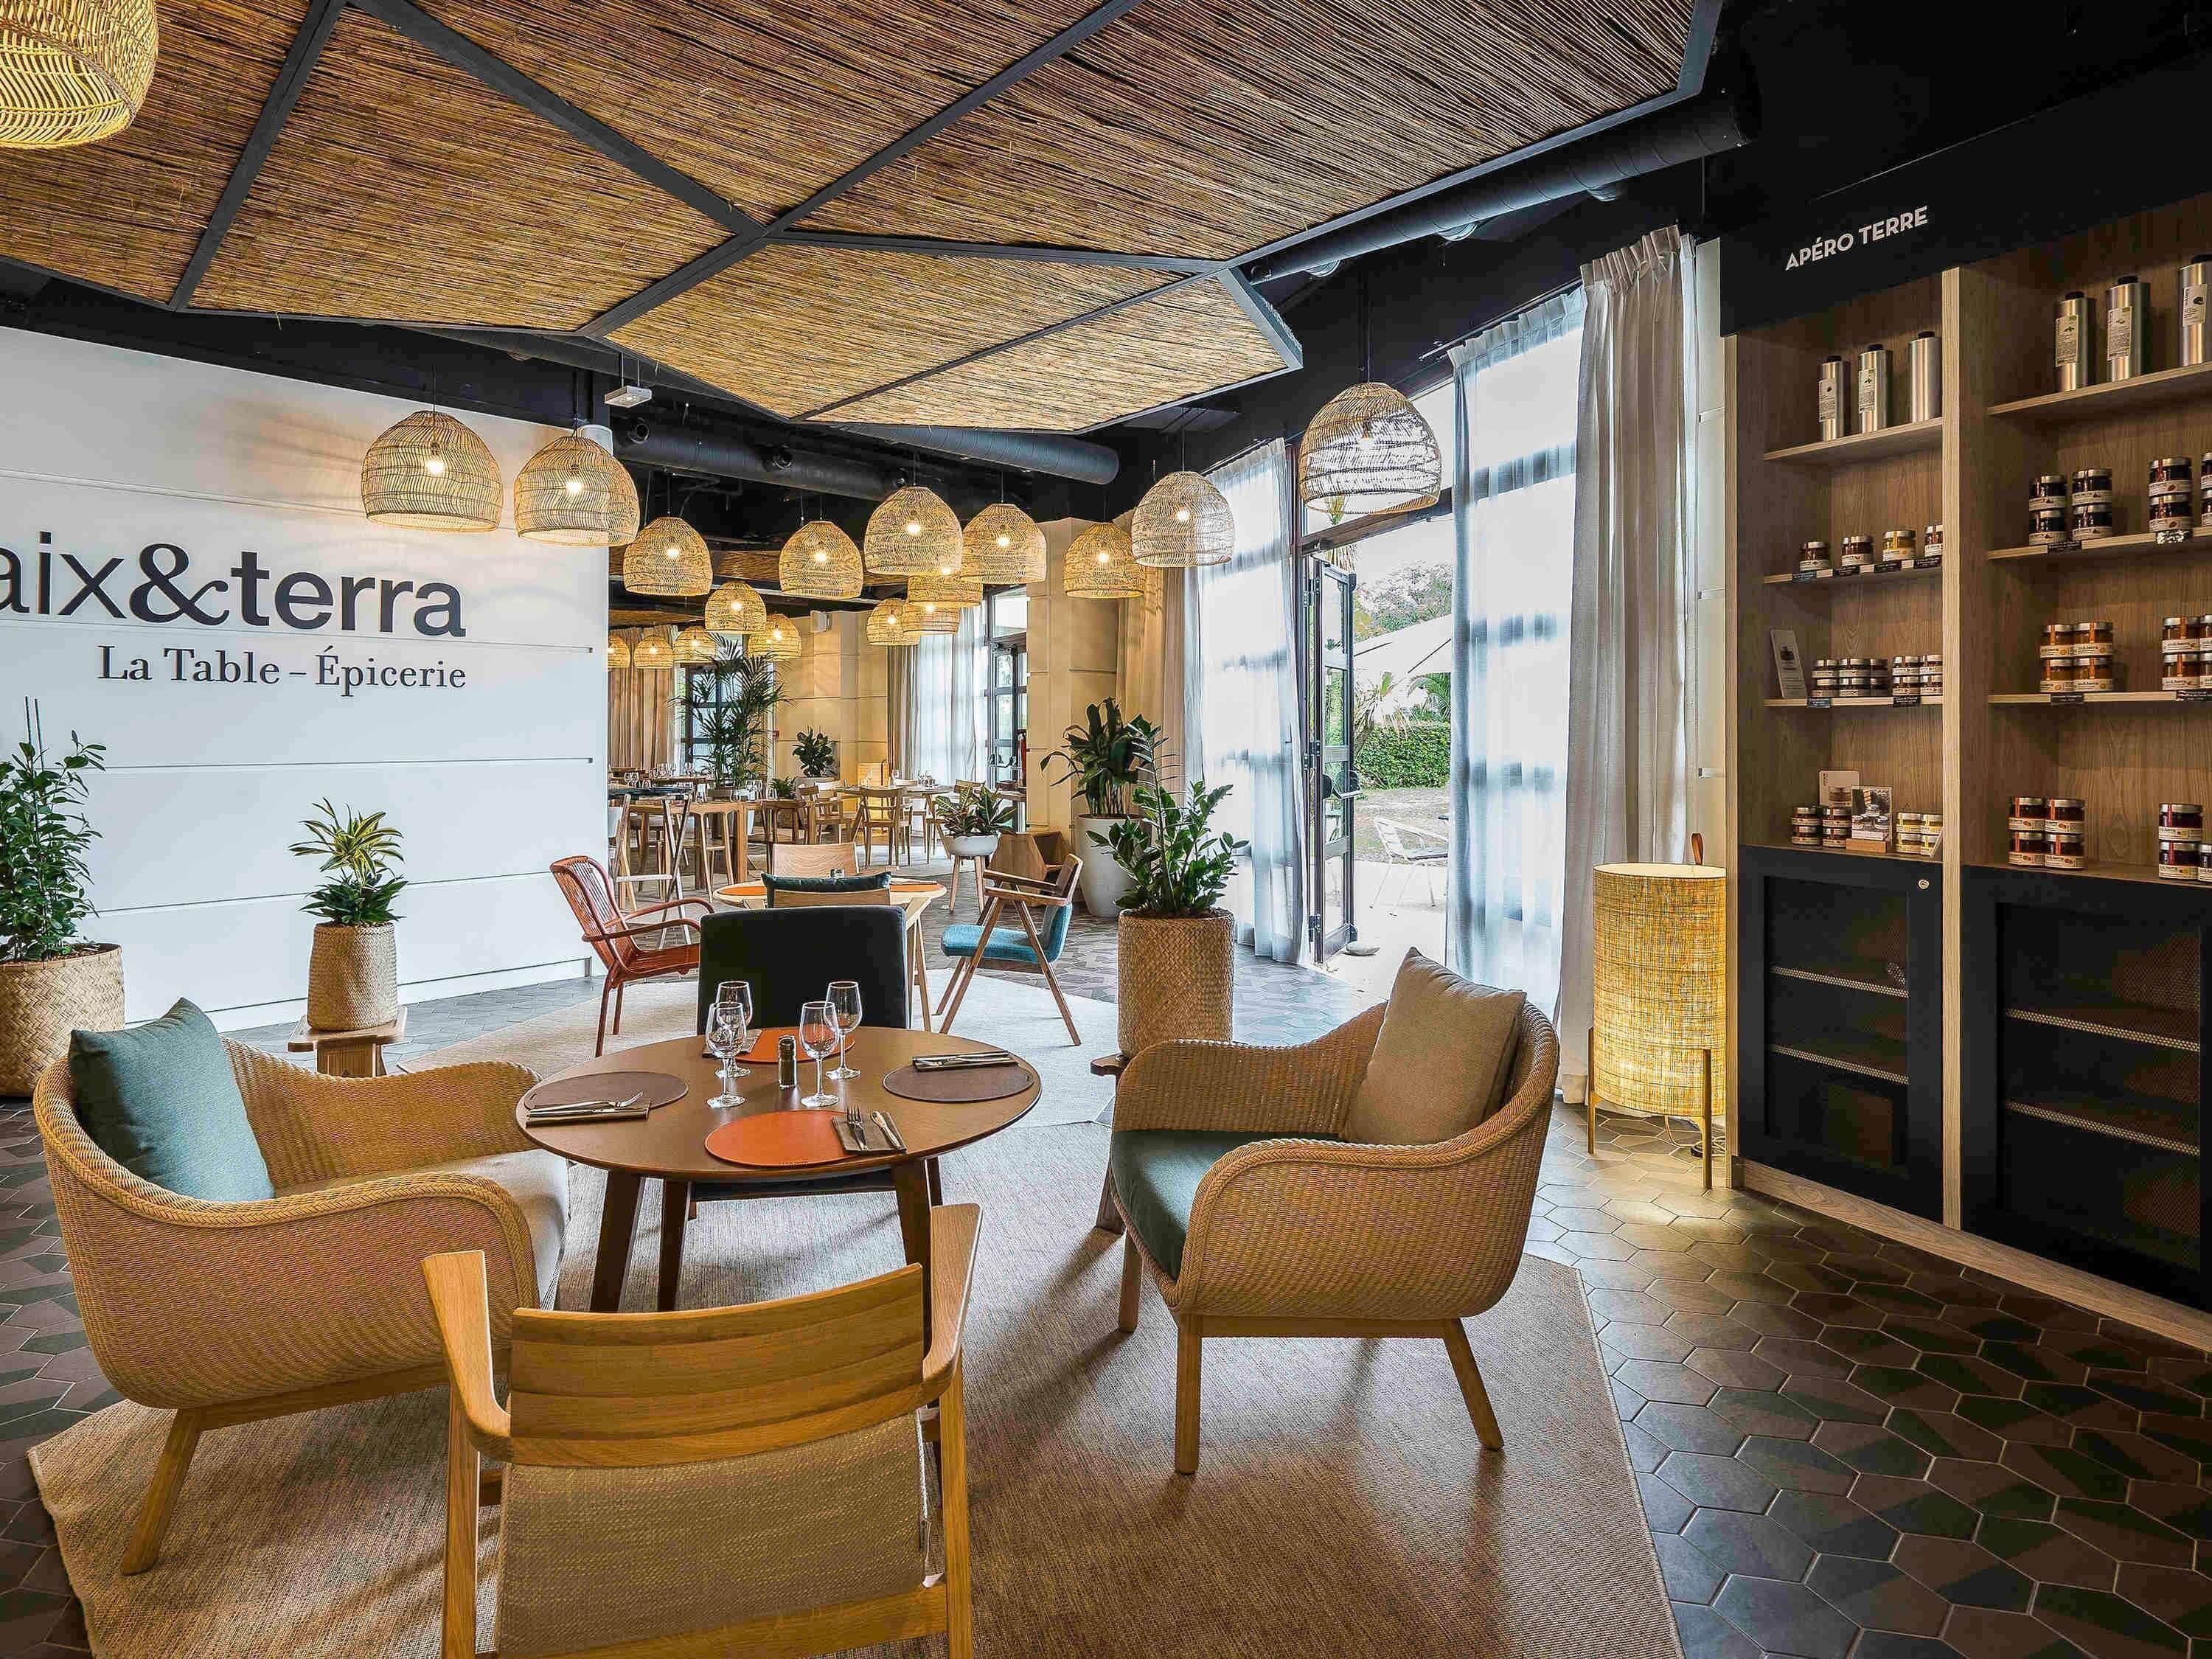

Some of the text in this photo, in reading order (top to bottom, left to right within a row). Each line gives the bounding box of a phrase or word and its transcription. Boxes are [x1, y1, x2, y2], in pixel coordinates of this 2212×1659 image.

[1785, 206, 1929, 271] APÉRO TERRE
[97, 645, 153, 681] La
[163, 647, 280, 684] Table
[315, 644, 466, 698] Épicerie
